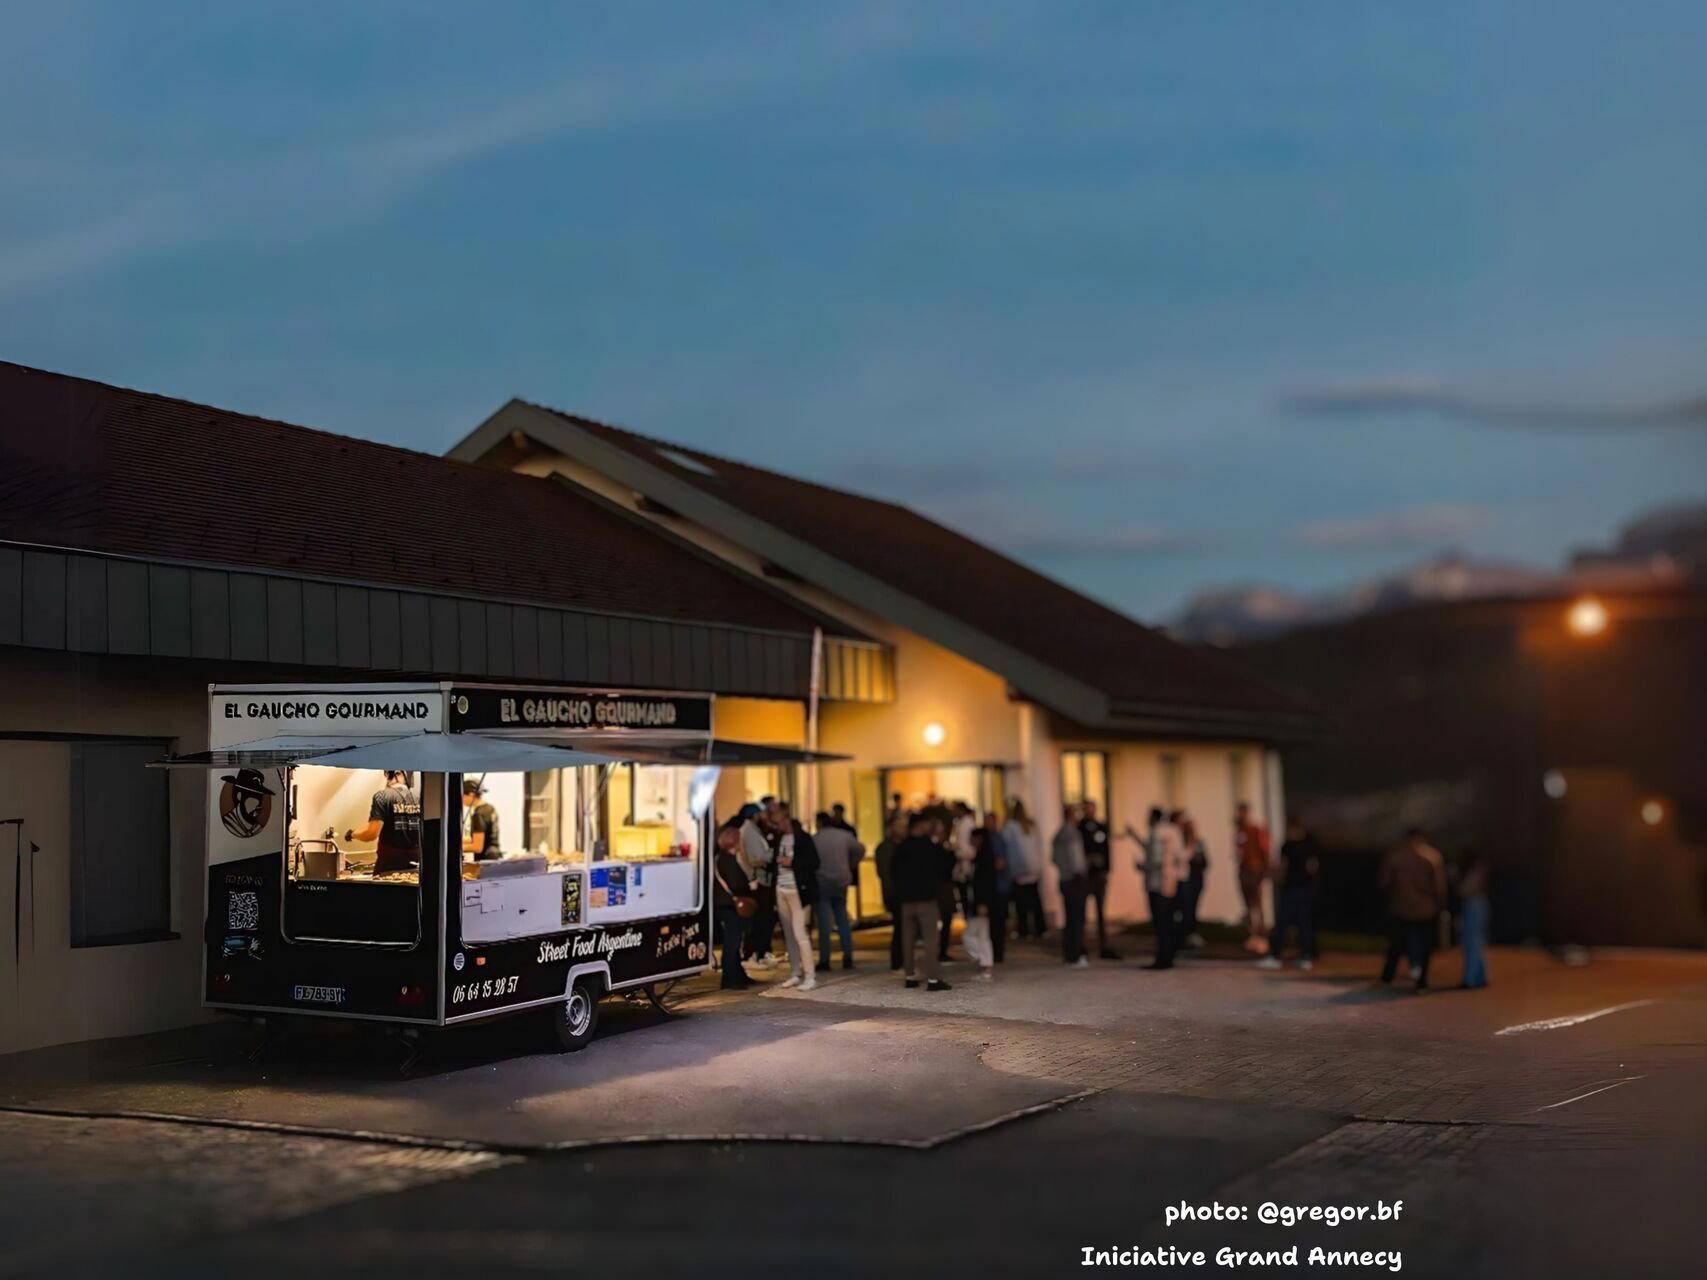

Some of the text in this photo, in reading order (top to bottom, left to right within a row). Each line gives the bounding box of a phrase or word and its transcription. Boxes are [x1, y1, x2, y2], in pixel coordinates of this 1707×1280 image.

[224, 702, 429, 720] EL GAUCHO GOURMAND
[501, 699, 677, 726] EL GAUCHO GOURMAND
[537, 938, 570, 964] Street
[572, 933, 597, 957] Food
[597, 928, 643, 961] Argentine
